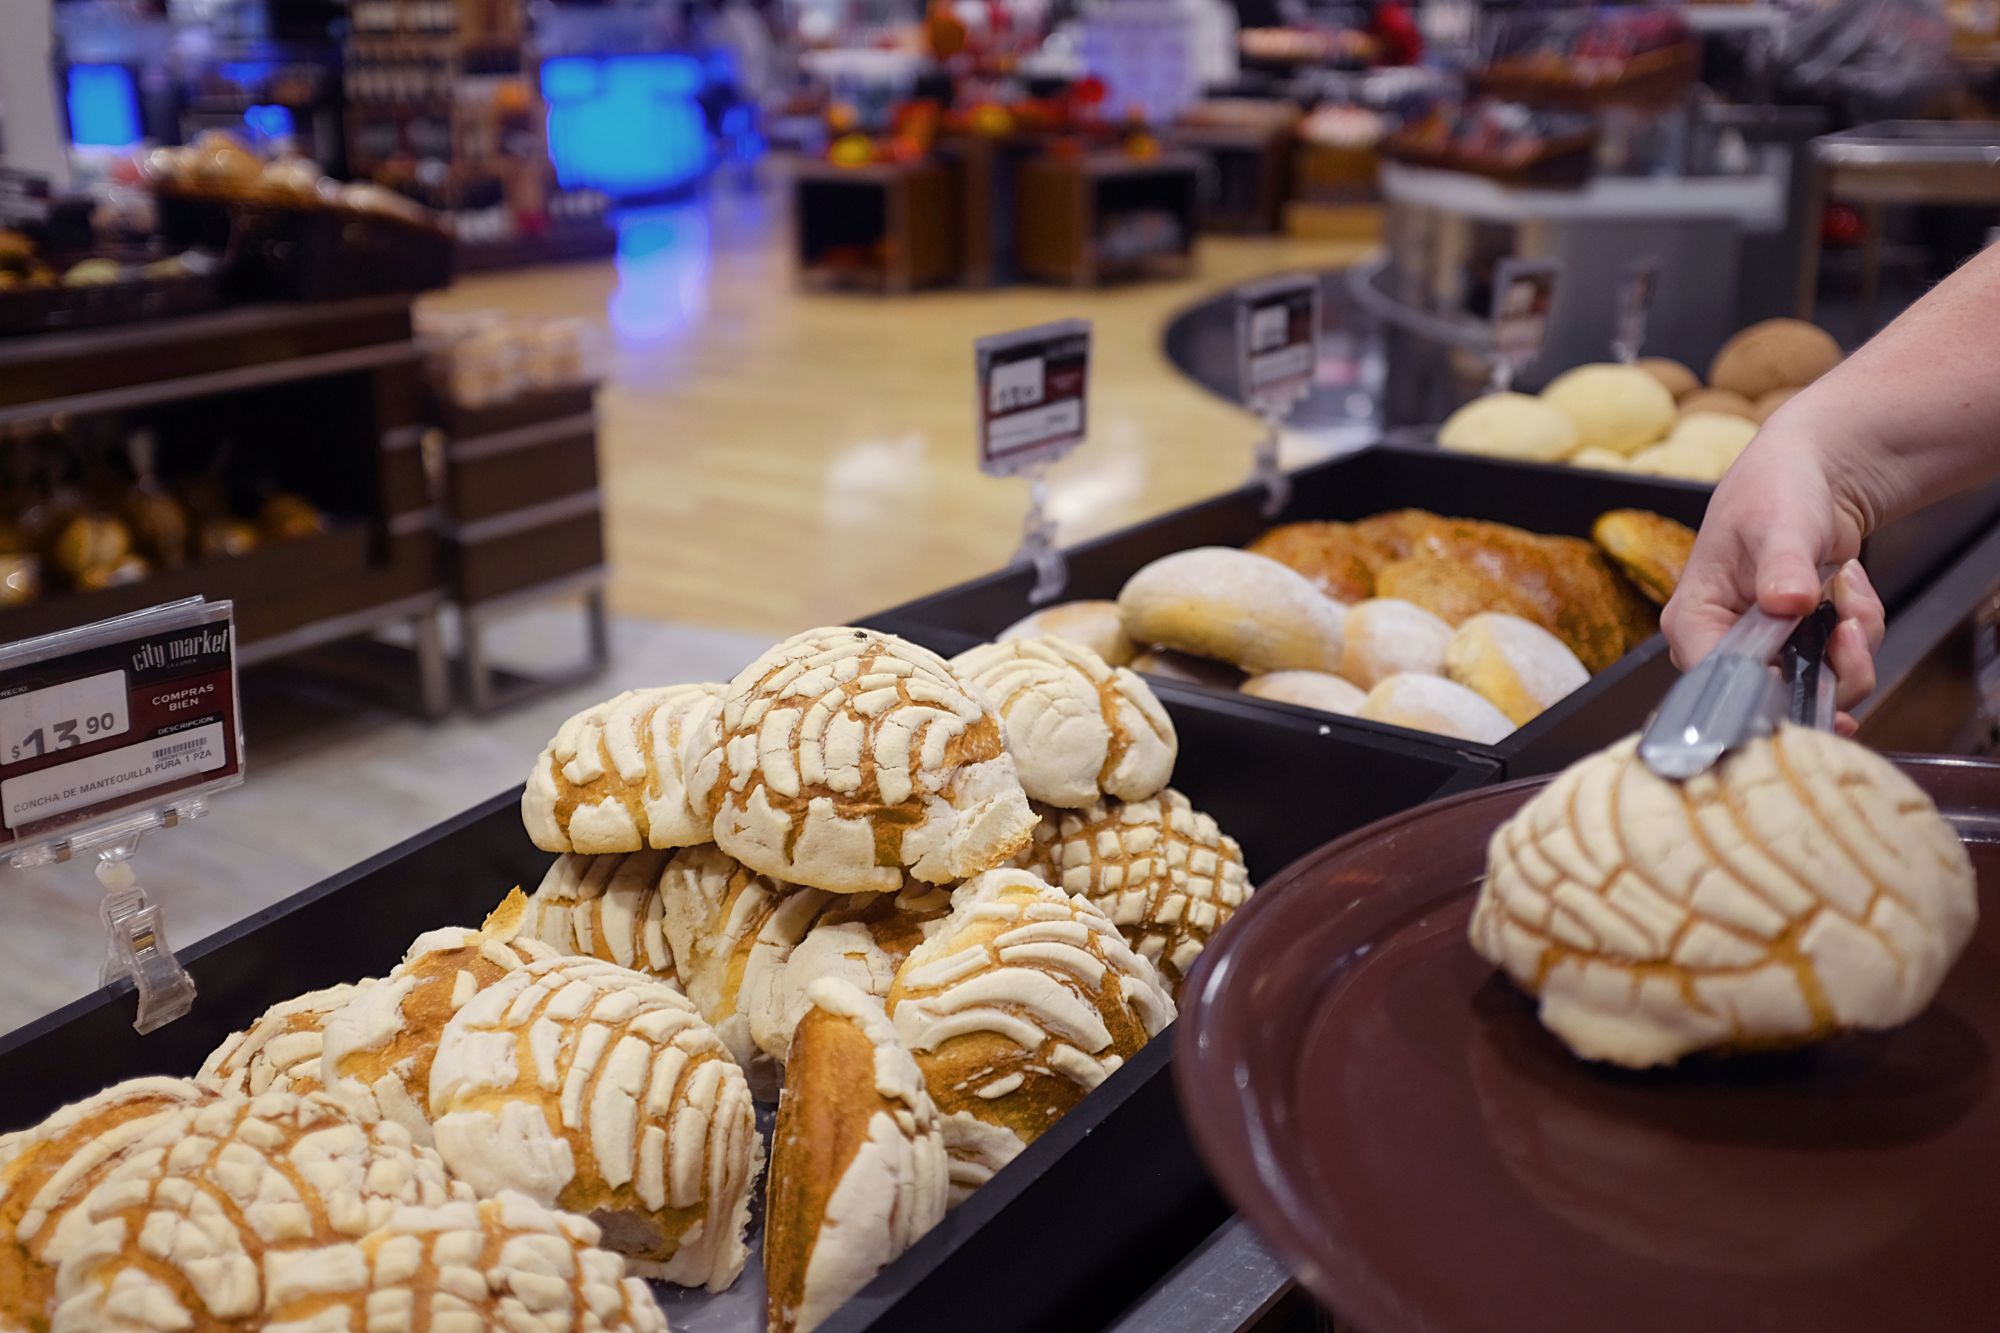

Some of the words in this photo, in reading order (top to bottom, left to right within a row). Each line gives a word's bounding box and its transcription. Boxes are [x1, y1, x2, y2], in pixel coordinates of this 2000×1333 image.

[132, 644, 164, 671] city
[169, 629, 228, 659] market
[152, 684, 214, 705] COMPRAS
[169, 698, 199, 711] BIEN
[13, 794, 59, 813] CONCHA
[63, 788, 77, 798] DE
[80, 767, 151, 793] MANTEQUILLA
[155, 759, 181, 772] PURA
[193, 750, 212, 761] PZA
